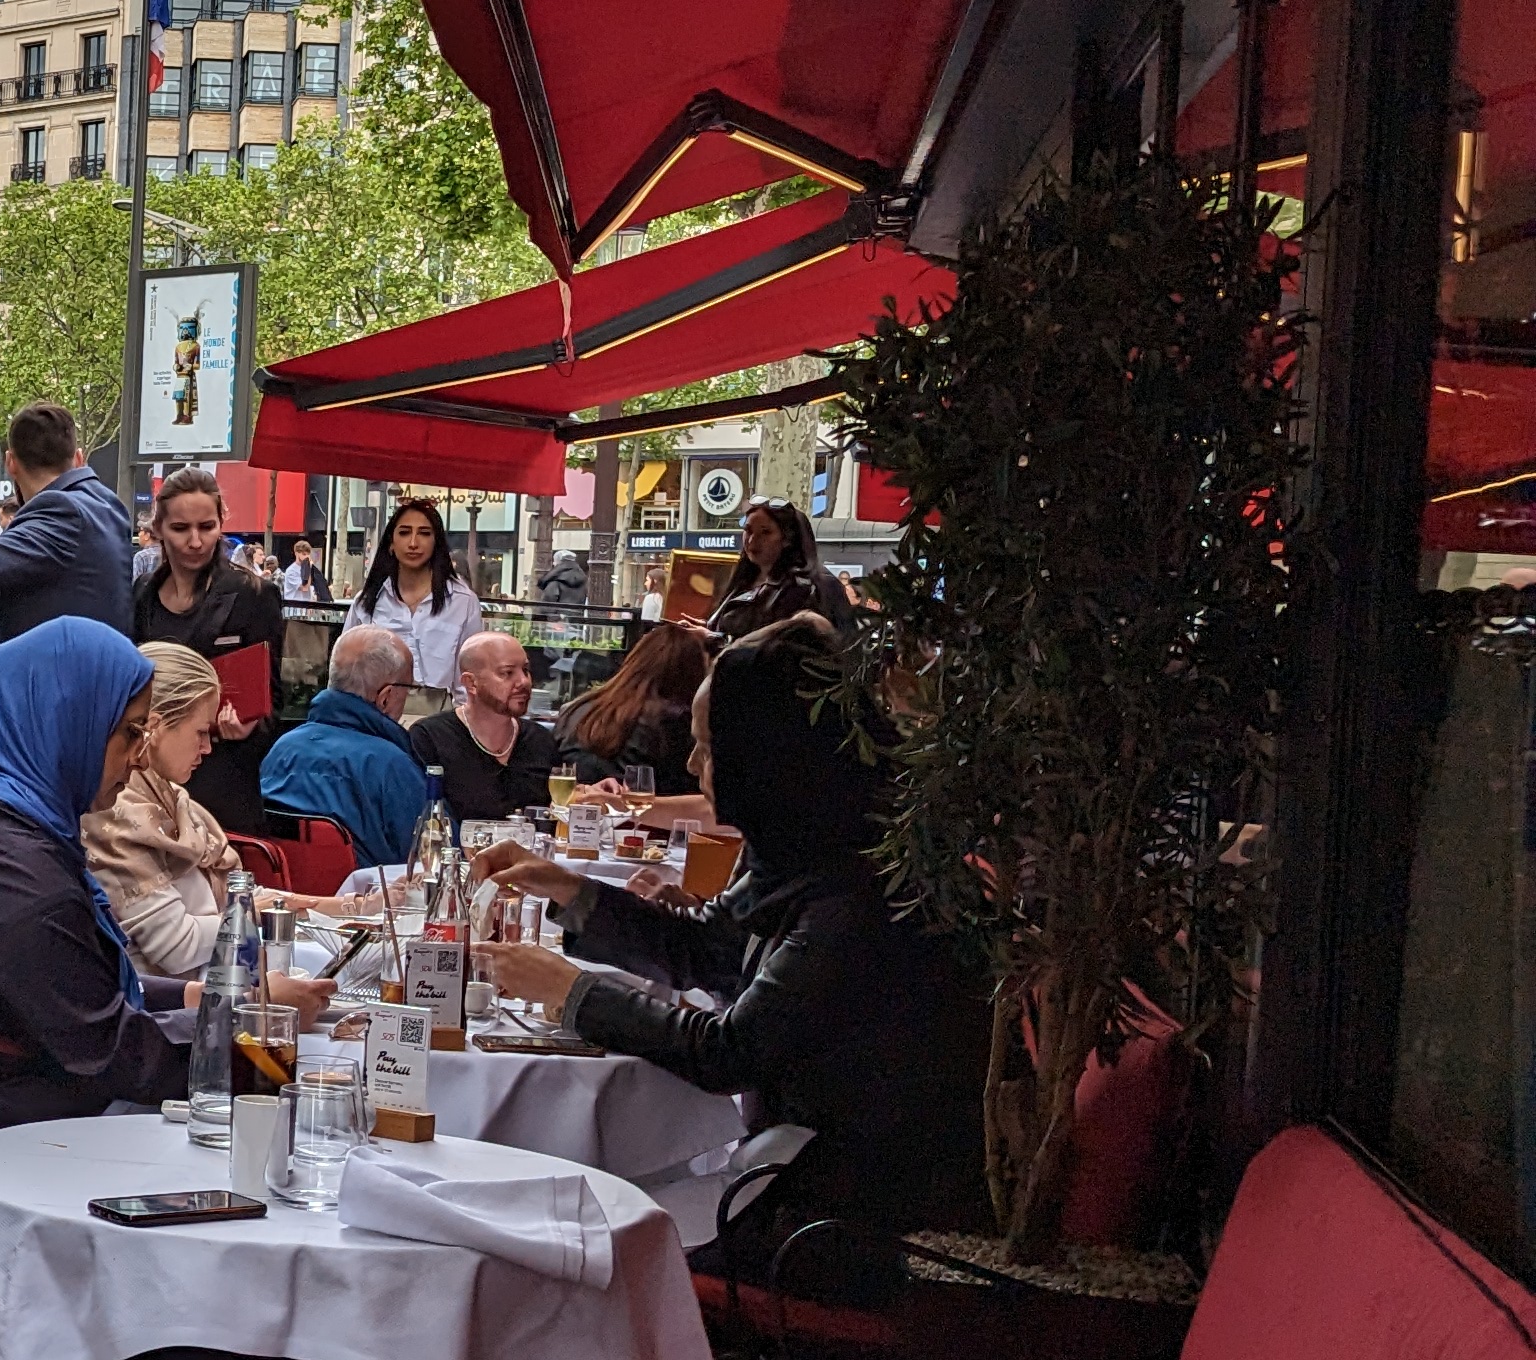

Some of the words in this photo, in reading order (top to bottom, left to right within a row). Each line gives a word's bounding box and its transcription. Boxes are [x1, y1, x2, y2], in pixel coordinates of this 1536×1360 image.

[204, 327, 211, 337] LE
[203, 338, 225, 347] MONDE
[203, 349, 211, 359] EN
[202, 359, 229, 369] FAMILLE
[631, 536, 666, 548] LIBERTÉ
[698, 535, 736, 549] QUALITÉ
[416, 980, 434, 991] Pay
[376, 1050, 398, 1066] Pay
[375, 1063, 391, 1074] the
[392, 1064, 411, 1076] bill
